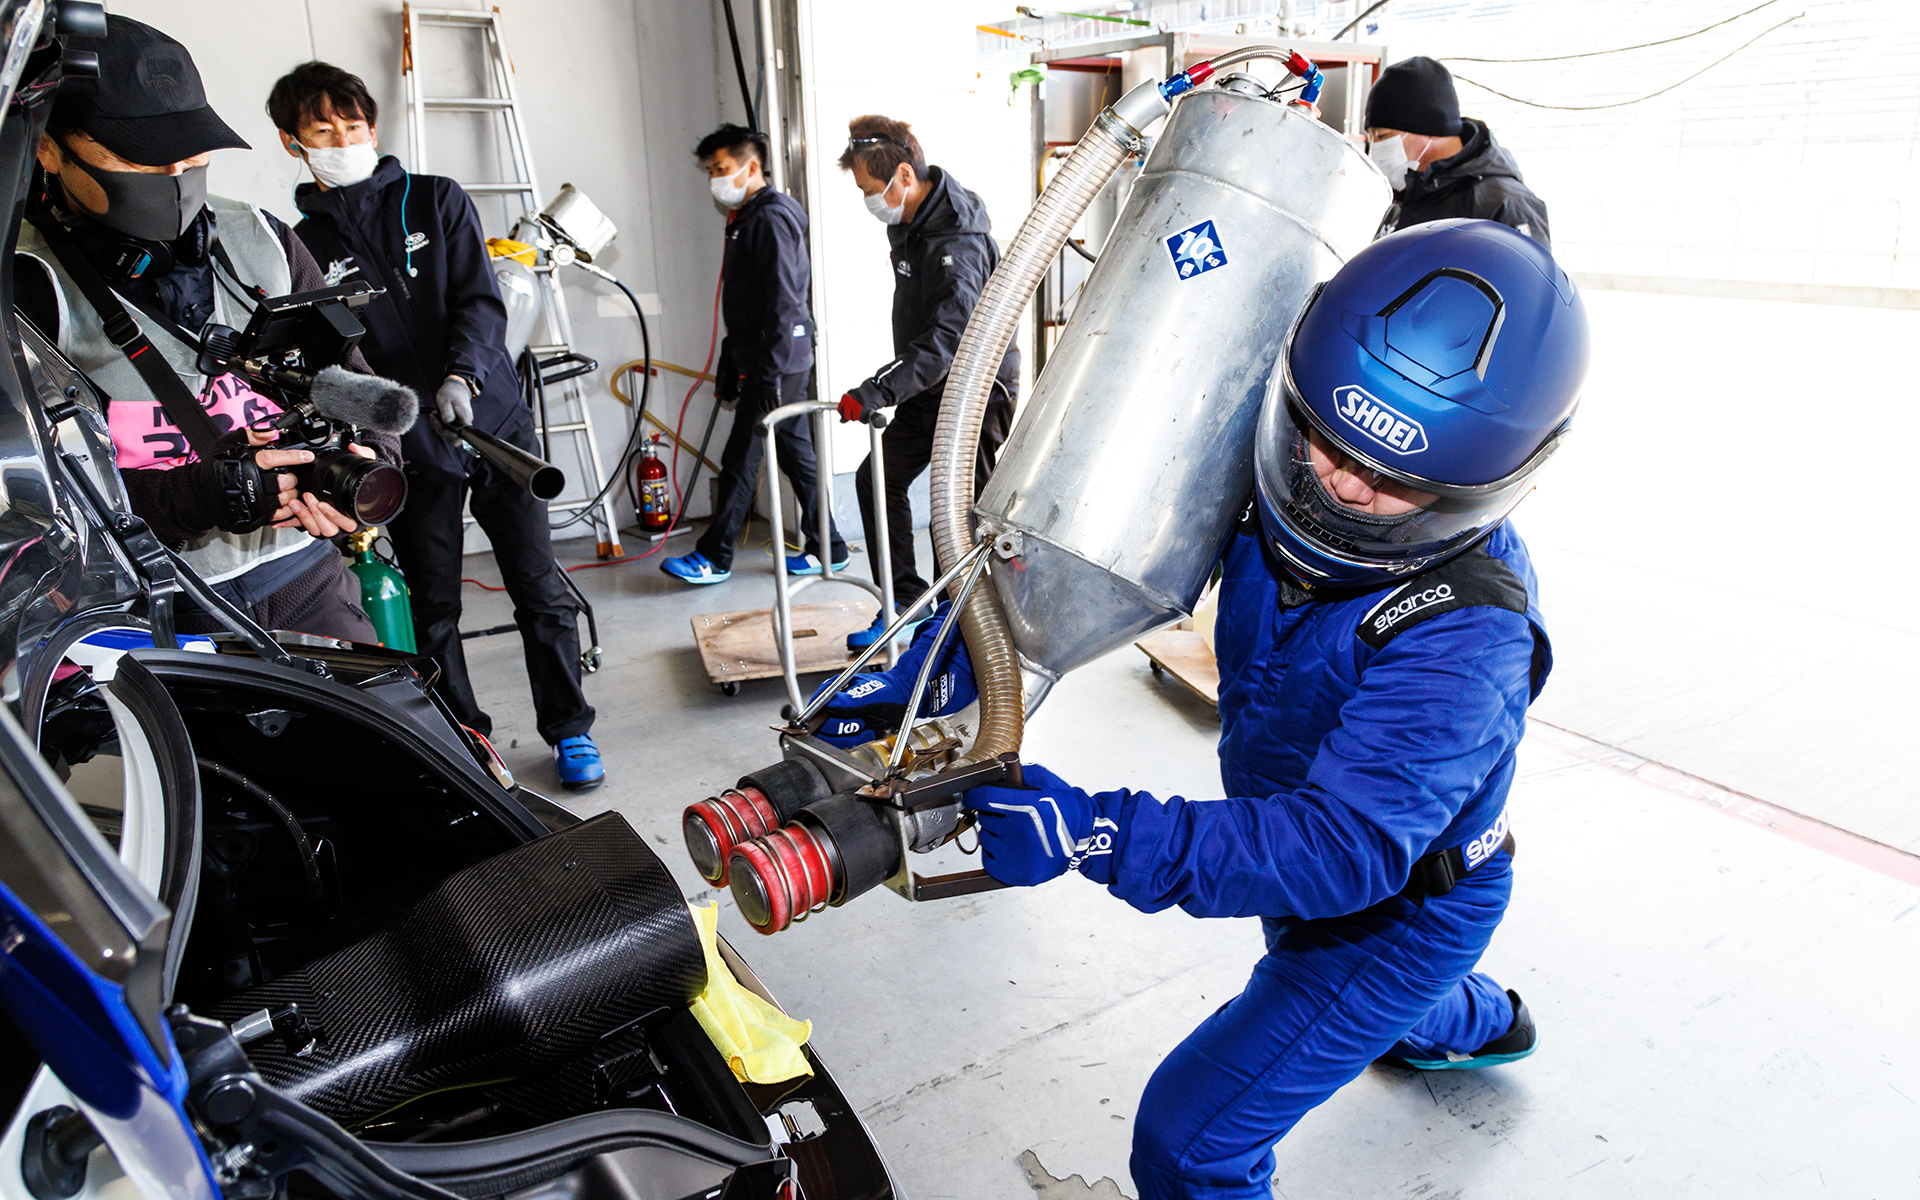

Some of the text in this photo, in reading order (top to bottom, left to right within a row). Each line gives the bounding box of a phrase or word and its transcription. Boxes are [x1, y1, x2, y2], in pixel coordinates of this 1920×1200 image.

[1340, 391, 1418, 451] SHOEI
[1374, 584, 1454, 631] sparco
[847, 680, 886, 698] sparco
[1637, 763, 1775, 822] LANE
